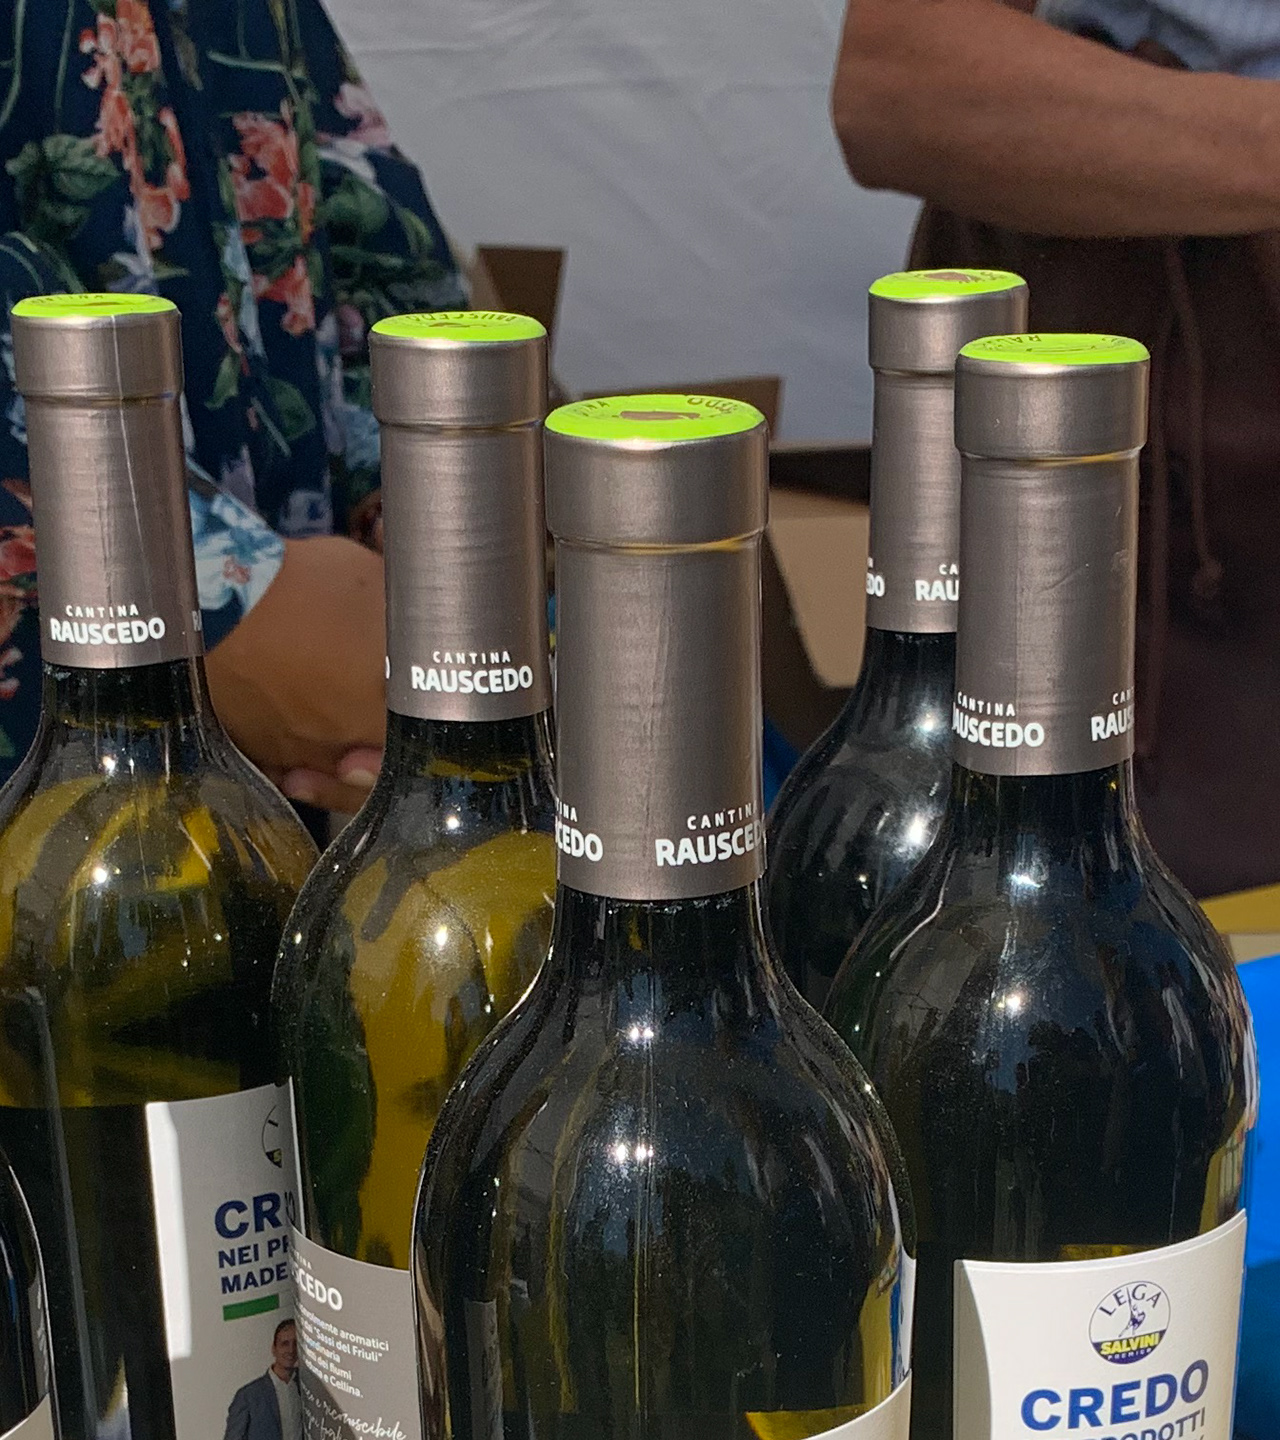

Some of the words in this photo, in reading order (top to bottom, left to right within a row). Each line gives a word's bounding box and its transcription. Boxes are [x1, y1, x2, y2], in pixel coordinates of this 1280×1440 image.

[65, 604, 140, 619] CANTINA
[50, 617, 166, 646] RAUSCEDO
[432, 651, 512, 665] CANTINA
[410, 665, 534, 694] RAUSCEDO
[957, 690, 1017, 717] CANTINA
[952, 702, 1045, 748] AUSCEDO
[555, 814, 604, 863] CEDO
[218, 1243, 260, 1269] NEI
[221, 1261, 289, 1295] MADE
[1099, 1283, 1163, 1318] LEGA
[335, 1339, 351, 1355] del
[339, 1329, 390, 1352] aromatici
[1100, 1332, 1161, 1357] SALVINI
[1020, 1359, 1210, 1432] CREDO
